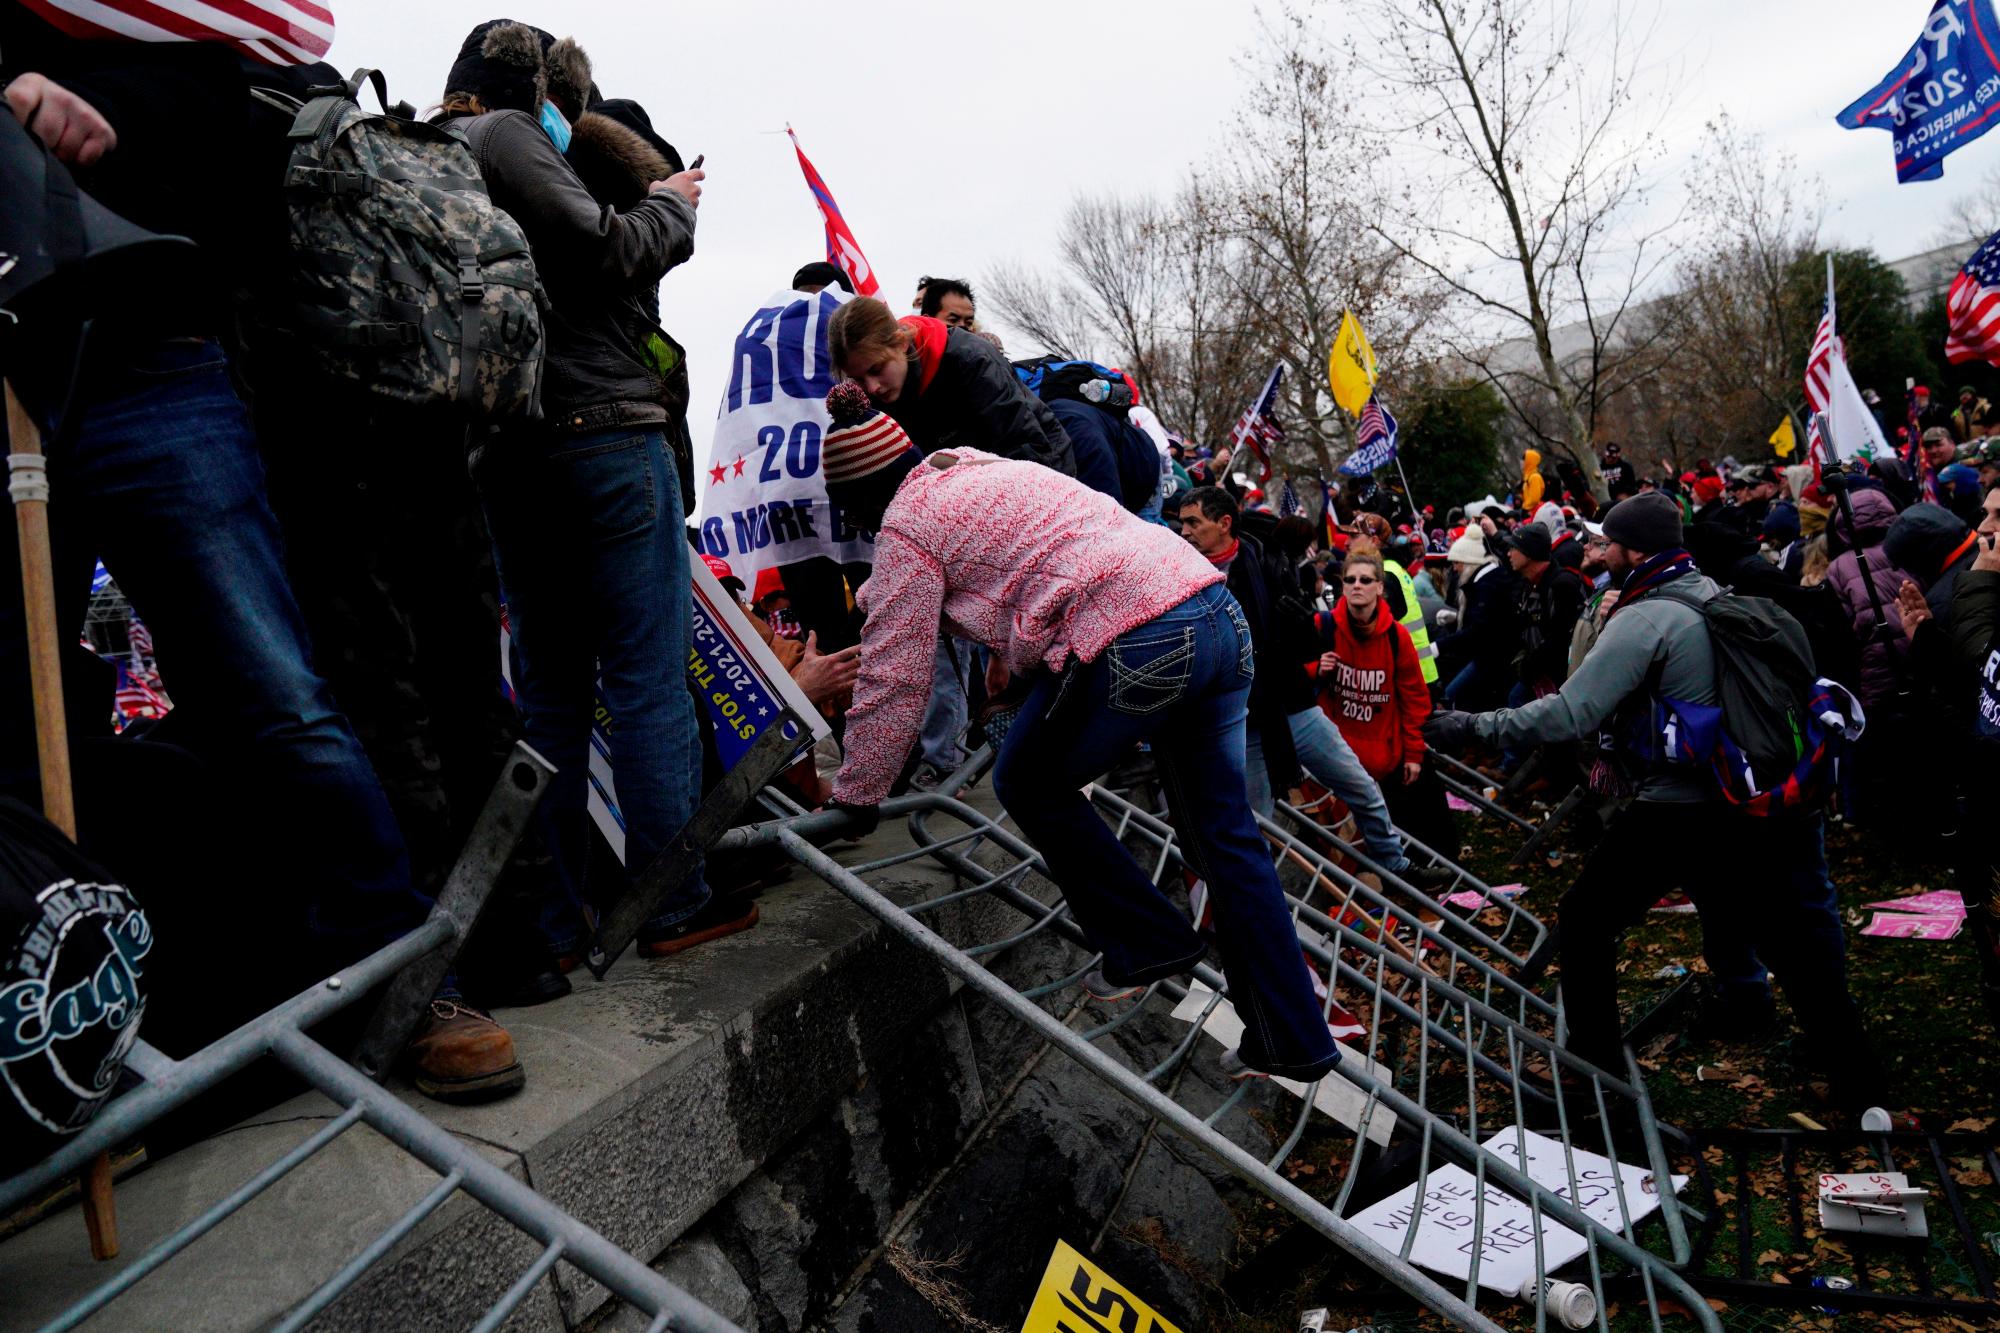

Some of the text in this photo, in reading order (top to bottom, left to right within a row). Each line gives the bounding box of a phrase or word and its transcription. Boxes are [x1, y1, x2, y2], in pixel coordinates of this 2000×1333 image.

[728, 291, 842, 414] RU
[698, 516, 730, 559] O
[731, 498, 820, 555] MORE
[1336, 661, 1386, 691] TRUMP
[1369, 694, 1390, 703] GREAT
[712, 692, 756, 740] STOP
[1342, 700, 1373, 722] 2020
[1372, 1182, 1473, 1230] WHERE
[1432, 1187, 1512, 1231] IS TH
[1457, 1170, 1625, 1263] FREE ESS
